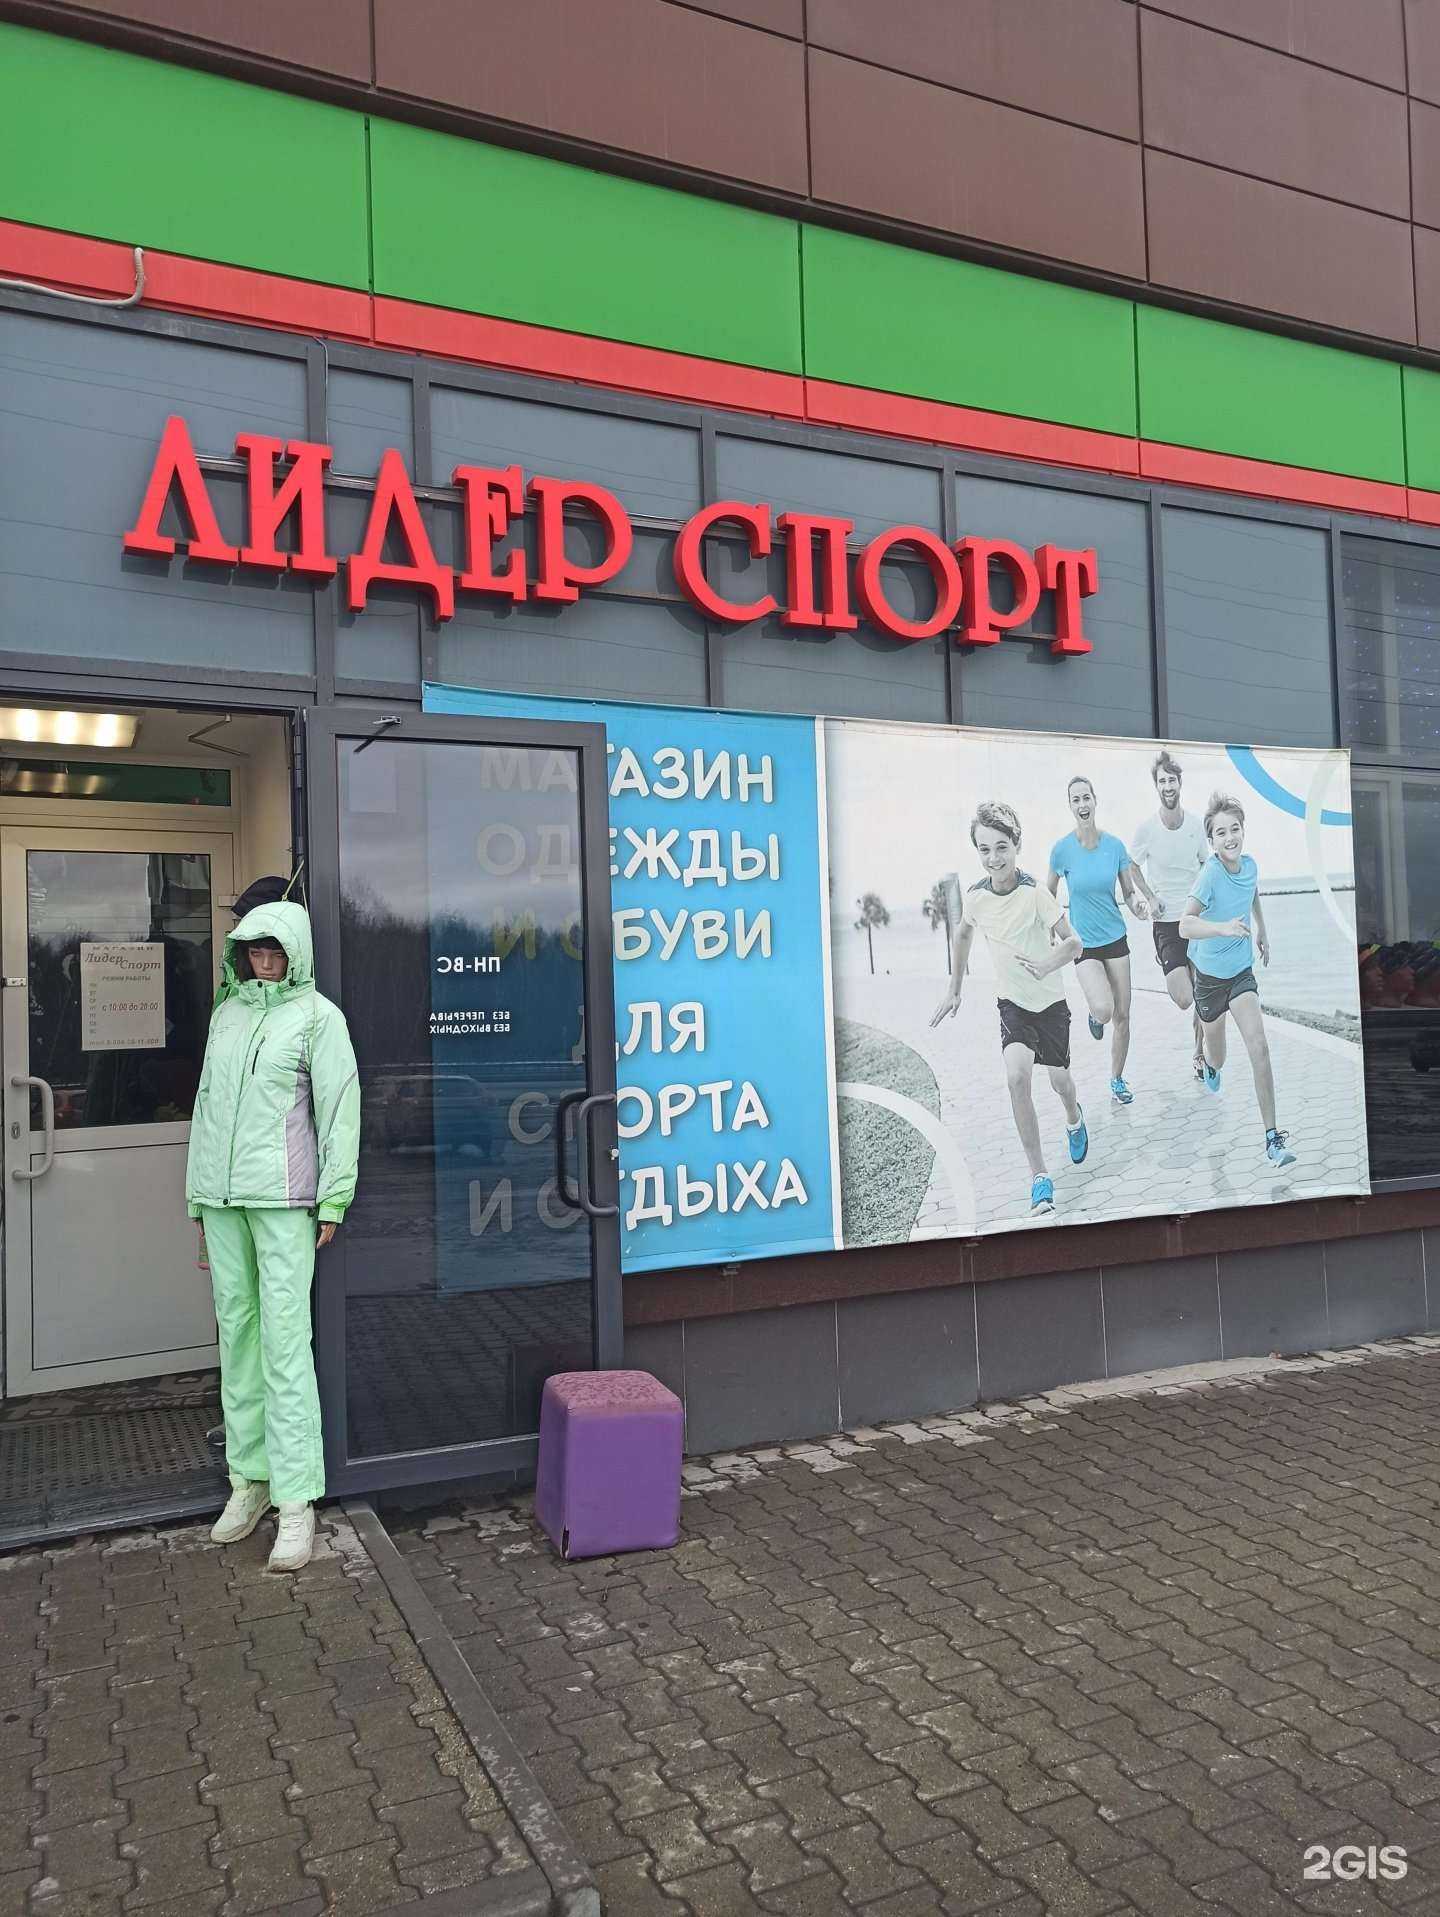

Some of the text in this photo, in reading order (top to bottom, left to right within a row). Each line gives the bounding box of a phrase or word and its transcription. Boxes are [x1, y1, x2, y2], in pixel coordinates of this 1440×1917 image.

[123, 414, 1098, 656] ЛИДЕР СПОРТ
[479, 745, 775, 804] МААЗИН
[84, 952, 123, 965] Лидер
[119, 959, 162, 972] Спорт
[469, 1158, 808, 1237] И ОДЫХА
